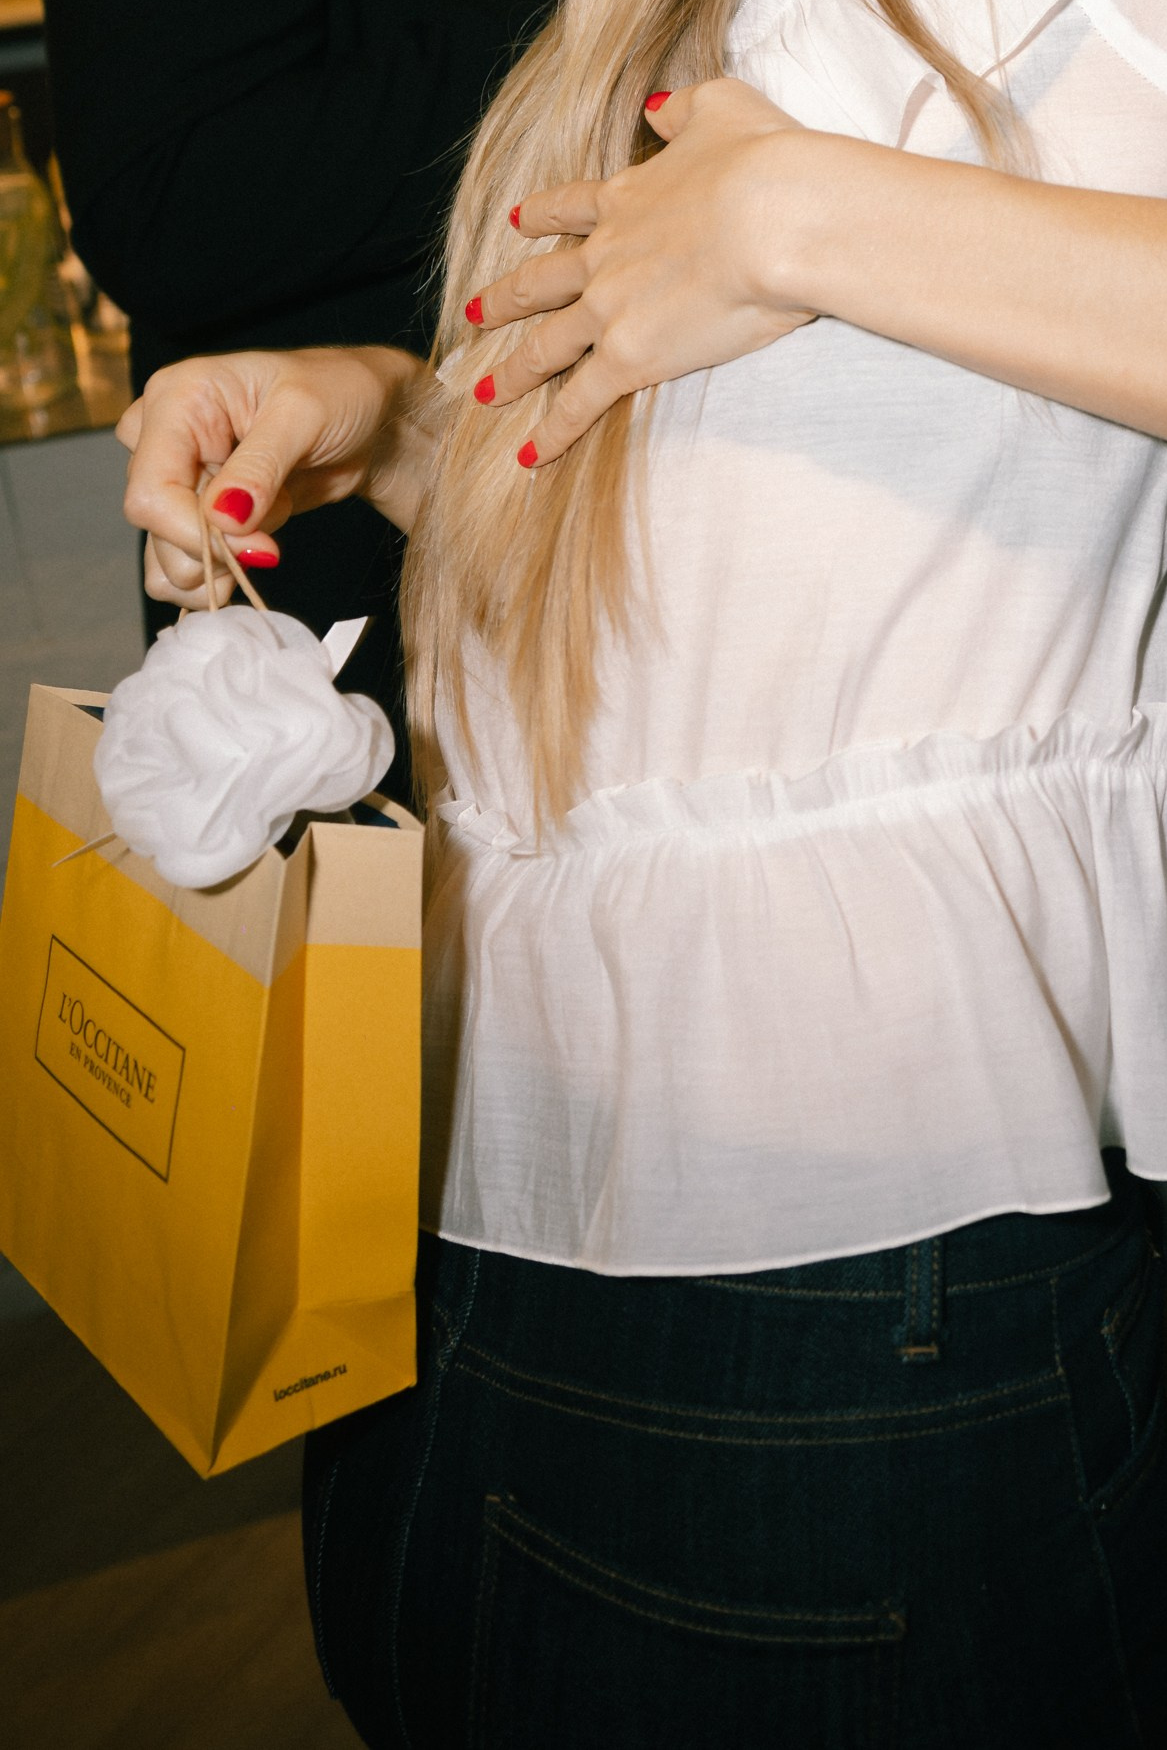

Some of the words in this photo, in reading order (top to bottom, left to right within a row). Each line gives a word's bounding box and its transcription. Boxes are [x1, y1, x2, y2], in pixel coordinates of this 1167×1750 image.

[69, 1041, 82, 1062] EN
[83, 1055, 132, 1108] PROVENCE
[273, 1363, 347, 1403] loccitane.ru
